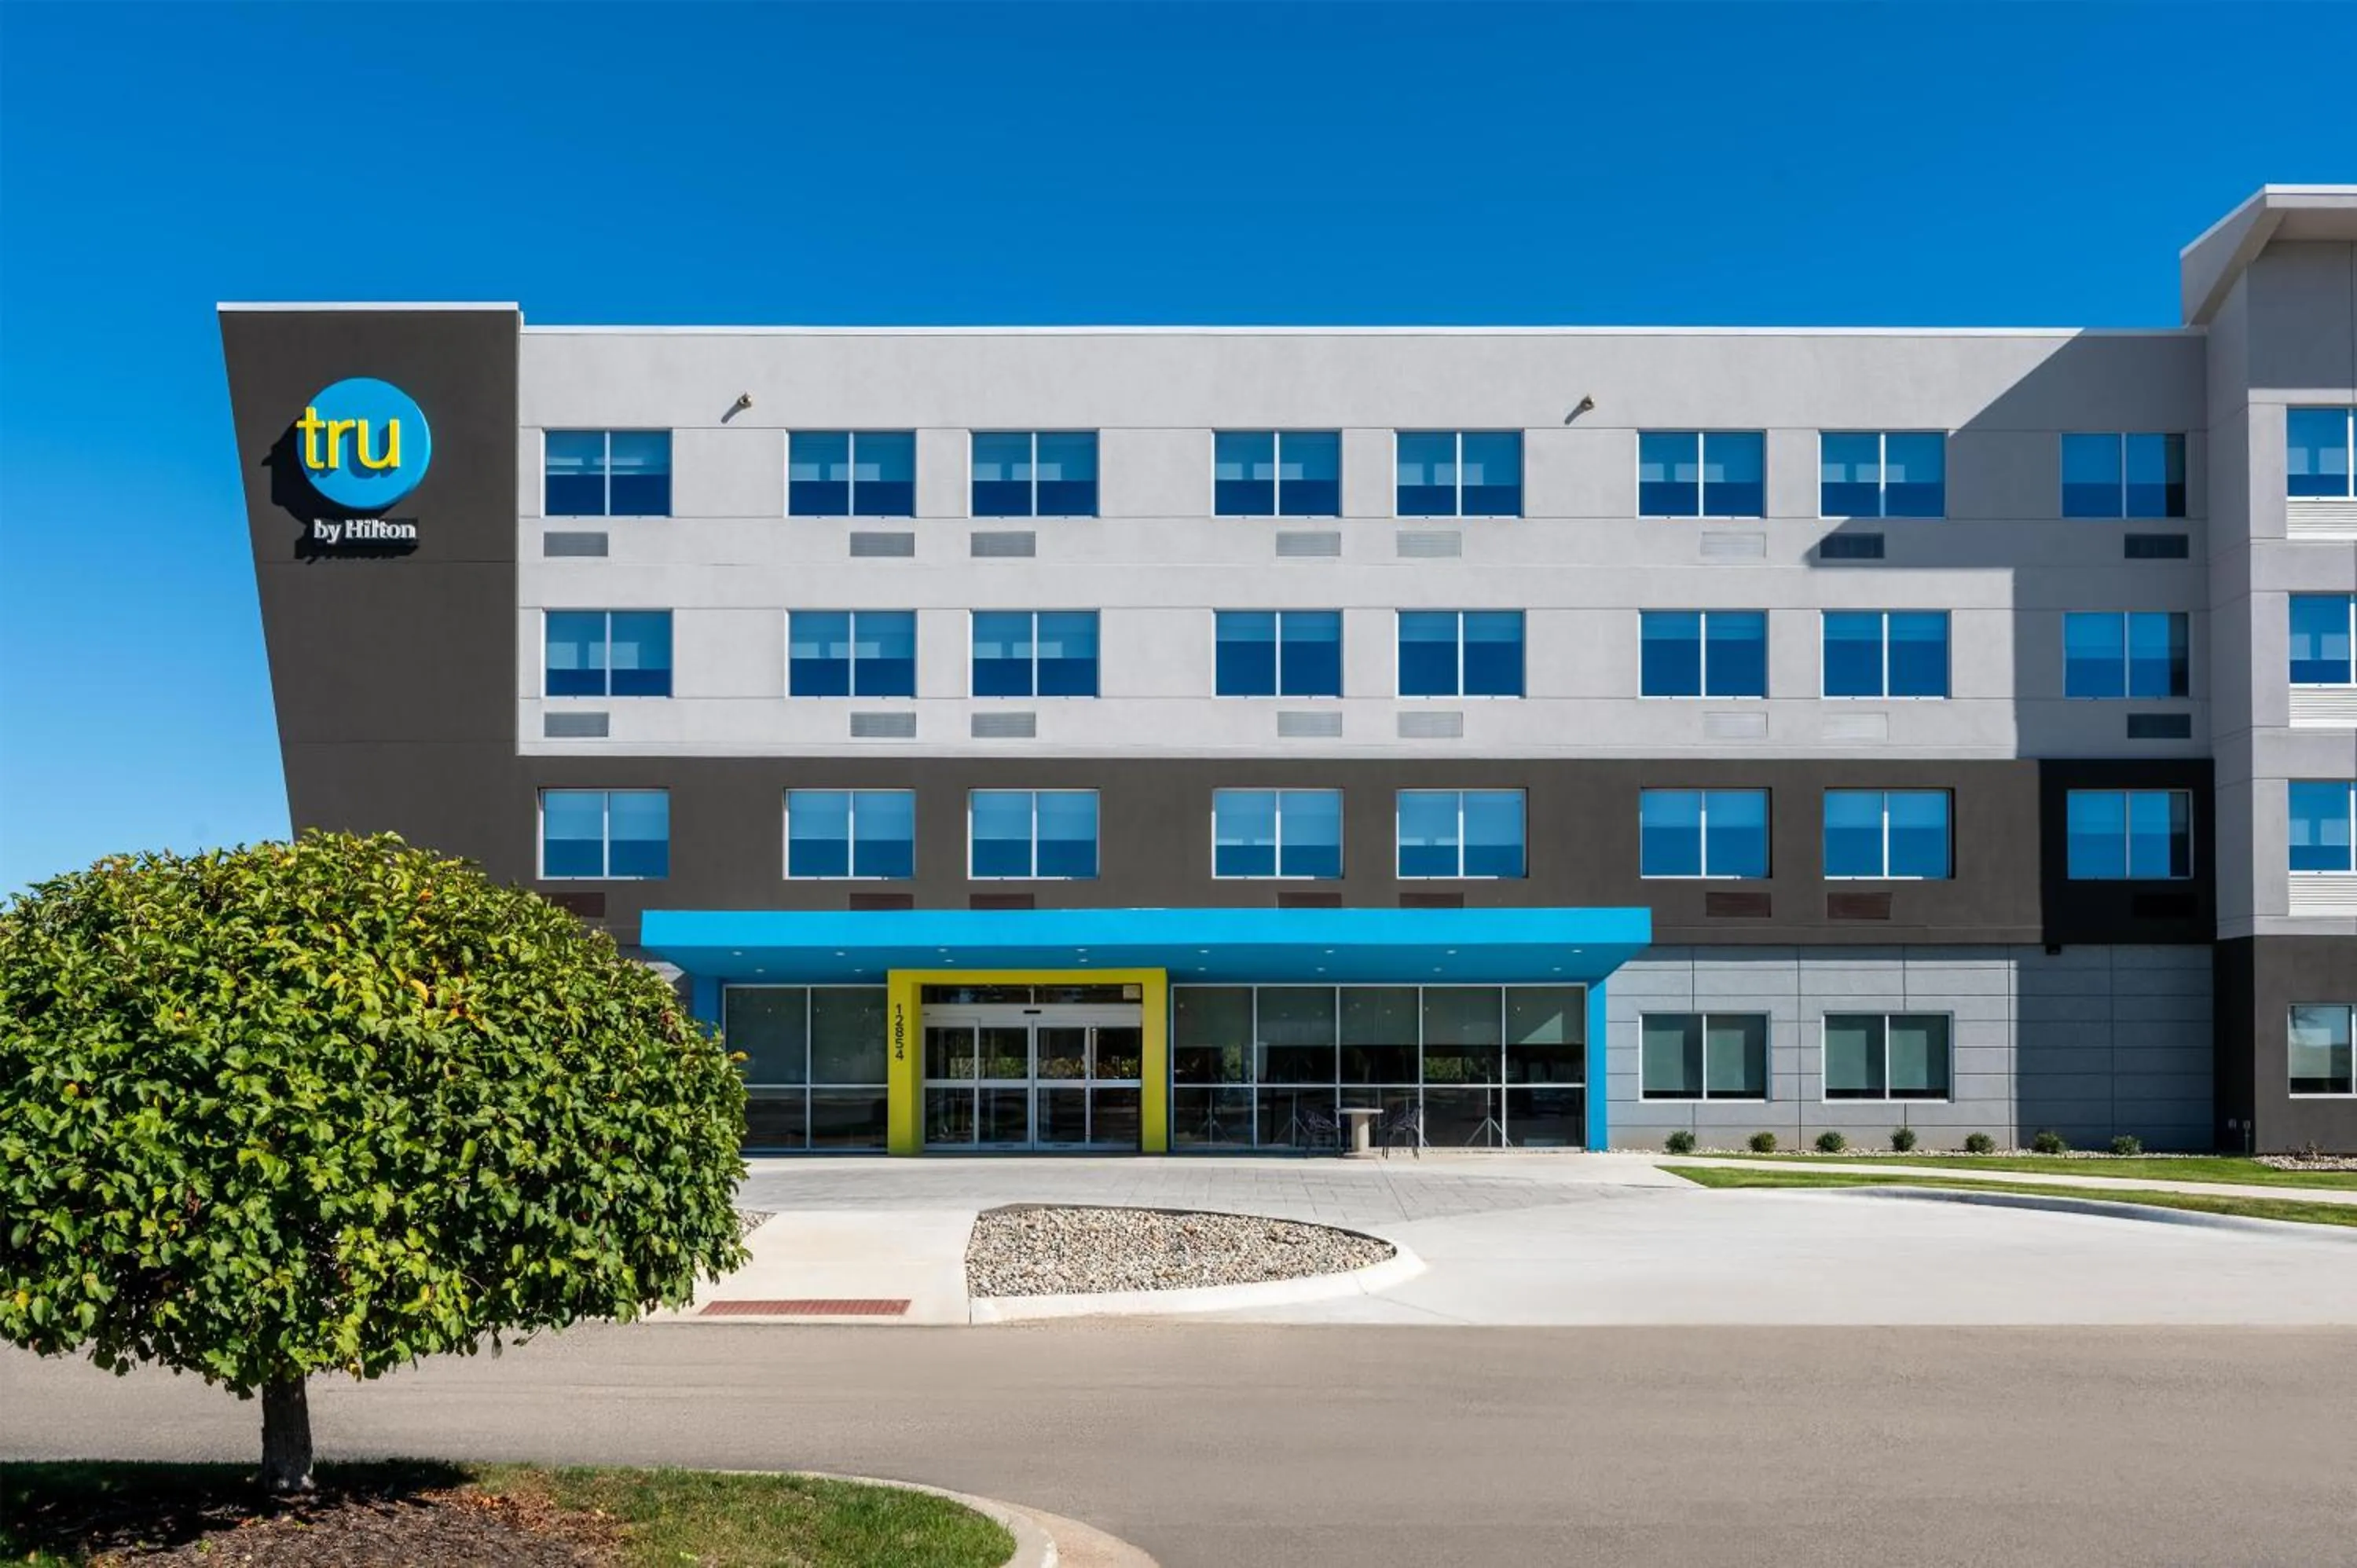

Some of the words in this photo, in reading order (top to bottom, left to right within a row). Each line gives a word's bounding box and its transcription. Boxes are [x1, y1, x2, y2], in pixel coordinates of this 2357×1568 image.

[296, 406, 401, 469] tru
[313, 518, 341, 544] by
[345, 518, 416, 539] Hilton
[895, 1003, 904, 1061] 12854
